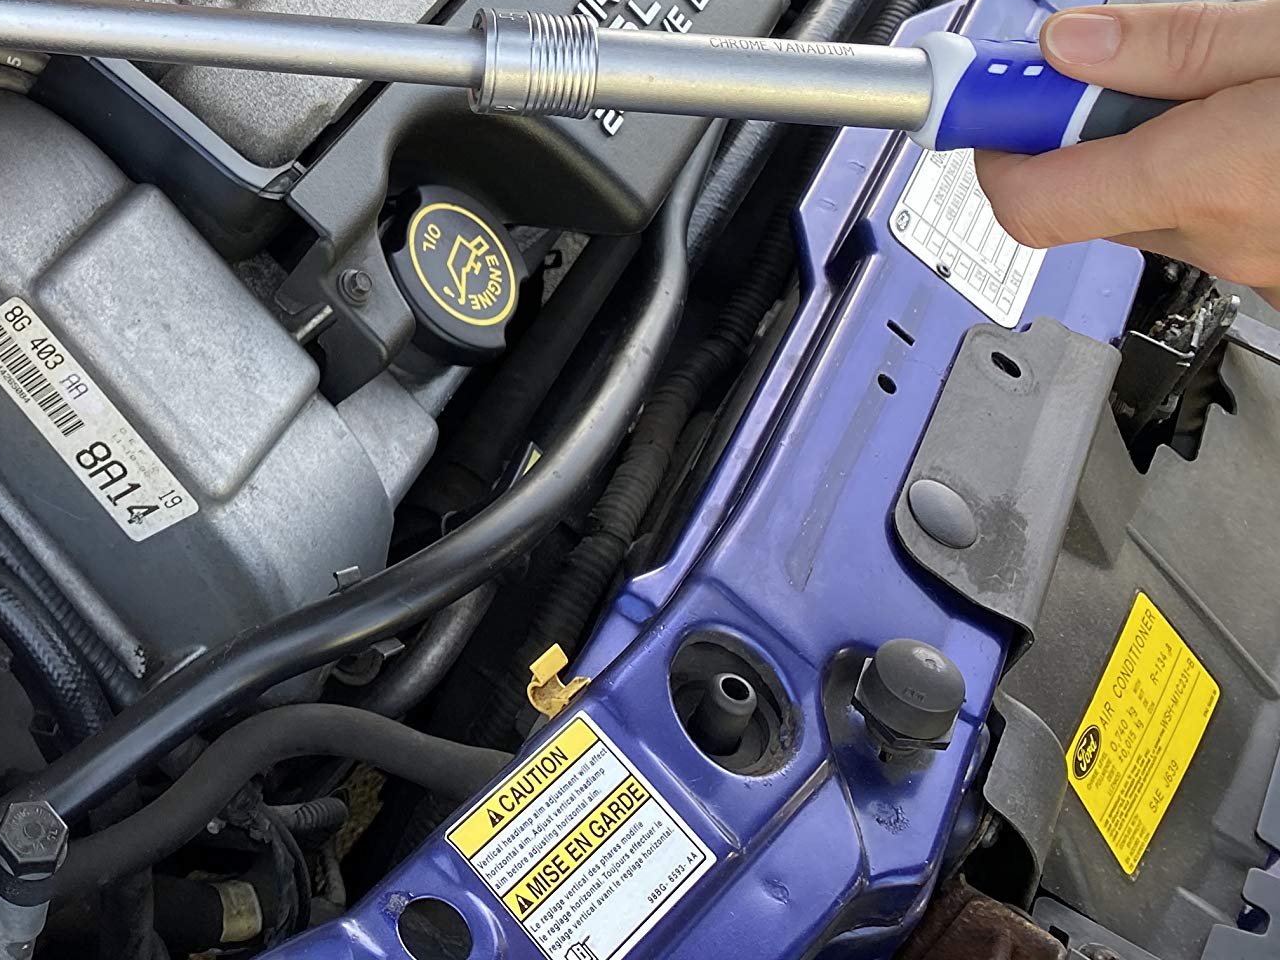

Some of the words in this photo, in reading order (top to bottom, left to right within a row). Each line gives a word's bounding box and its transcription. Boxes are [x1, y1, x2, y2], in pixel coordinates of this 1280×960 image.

[709, 37, 769, 51] CHROME
[772, 40, 855, 57] VANADIUM
[423, 224, 441, 251] OIL
[468, 254, 502, 310] ENGINE
[30, 337, 64, 369] 403
[59, 373, 88, 399] AA
[75, 441, 159, 523] 8A14
[158, 489, 182, 508] 19
[1075, 732, 1099, 771] Ford
[1094, 701, 1116, 729] AIR
[1111, 608, 1157, 699] CONDITIONER
[1126, 705, 1139, 718] kg
[1132, 718, 1145, 730] kg
[477, 844, 502, 868] Vertical
[502, 817, 532, 846] headlamp
[533, 806, 545, 818] aim
[545, 774, 578, 807] adjustment
[578, 763, 589, 776] will
[589, 748, 607, 765] affect
[499, 746, 567, 811] CAUTION
[1146, 787, 1166, 813] SAE
[1159, 758, 1181, 788] J639
[485, 847, 518, 879] horizontal
[532, 815, 553, 836] Adjust
[552, 793, 576, 816] vertical
[574, 768, 604, 795] headlamp
[495, 876, 507, 889] aim
[506, 857, 528, 877] before
[528, 829, 558, 857] adjusting
[555, 799, 587, 830] horizontal
[526, 854, 569, 899] MISE
[564, 832, 592, 861] EN
[589, 782, 644, 837] GARDE
[530, 923, 540, 932] Le
[540, 899, 564, 923] reglage
[564, 874, 588, 899] vertical
[588, 864, 600, 876] des
[600, 843, 621, 866] phares
[620, 821, 643, 844] modifie
[547, 911, 571, 935] reglage
[601, 853, 629, 879] Toujours
[629, 826, 655, 853] effectuer
[654, 820, 662, 828] le
[686, 852, 697, 863] AA
[548, 928, 572, 953] reglage
[572, 902, 596, 928] vertical
[596, 886, 614, 905] avant
[620, 858, 643, 881] reglage
